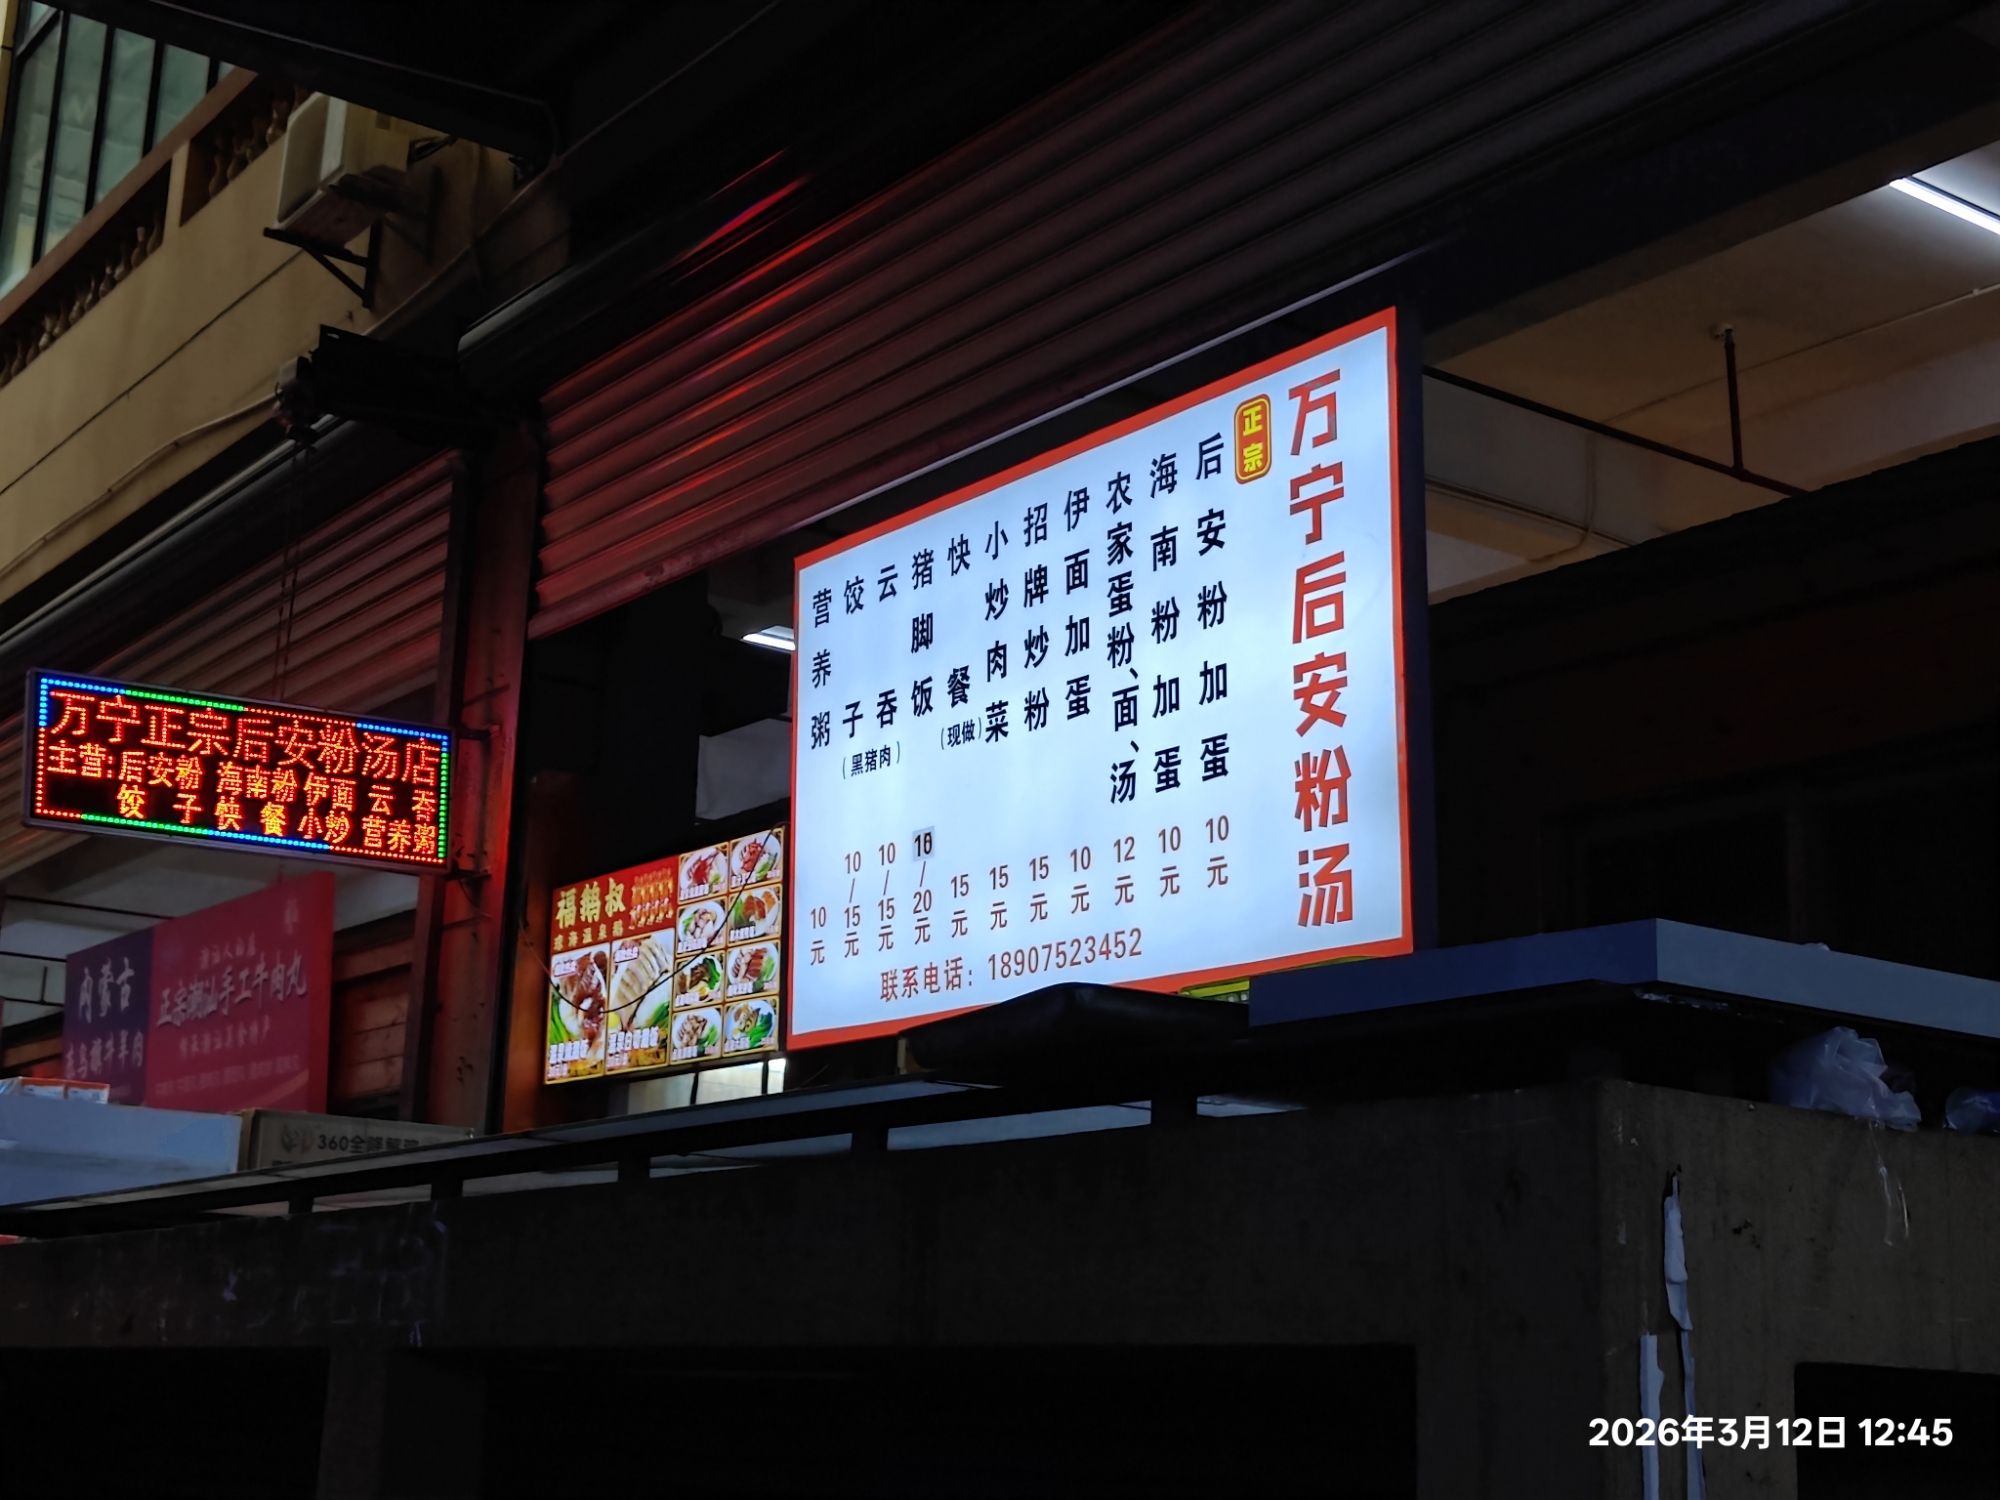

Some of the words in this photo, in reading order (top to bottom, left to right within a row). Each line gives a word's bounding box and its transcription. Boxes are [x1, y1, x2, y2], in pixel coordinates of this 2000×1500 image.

[1243, 405, 1264, 473] 正宗
[840, 575, 864, 738] 饺子
[875, 561, 899, 728] 云吞
[911, 546, 935, 717] 猪脚饭
[946, 530, 971, 708] 快餐
[984, 517, 1009, 743] 小炒肉菜
[1023, 499, 1049, 732] 招牌炒粉
[1063, 485, 1091, 720] 伊面加蛋
[1149, 450, 1182, 793] 海南粉加蛋
[1195, 432, 1230, 782] 后安粉加蛋
[1289, 369, 1353, 928] 万宁后安粉汤
[810, 585, 832, 750] 营养粥
[50, 691, 441, 787] 万宁正宗后安粉汤店
[362, 815, 437, 855] 营养粥
[1029, 856, 1049, 922] 15元
[1071, 846, 1091, 914] 10元
[1114, 837, 1135, 906] 12元
[1159, 826, 1181, 897] 10元
[1206, 815, 1229, 888] 10元
[810, 907, 826, 966] 10元
[844, 851, 860, 958] 10/15元
[878, 843, 895, 952] 10/15元
[951, 874, 969, 938] 15元
[990, 865, 1008, 930] 15元
